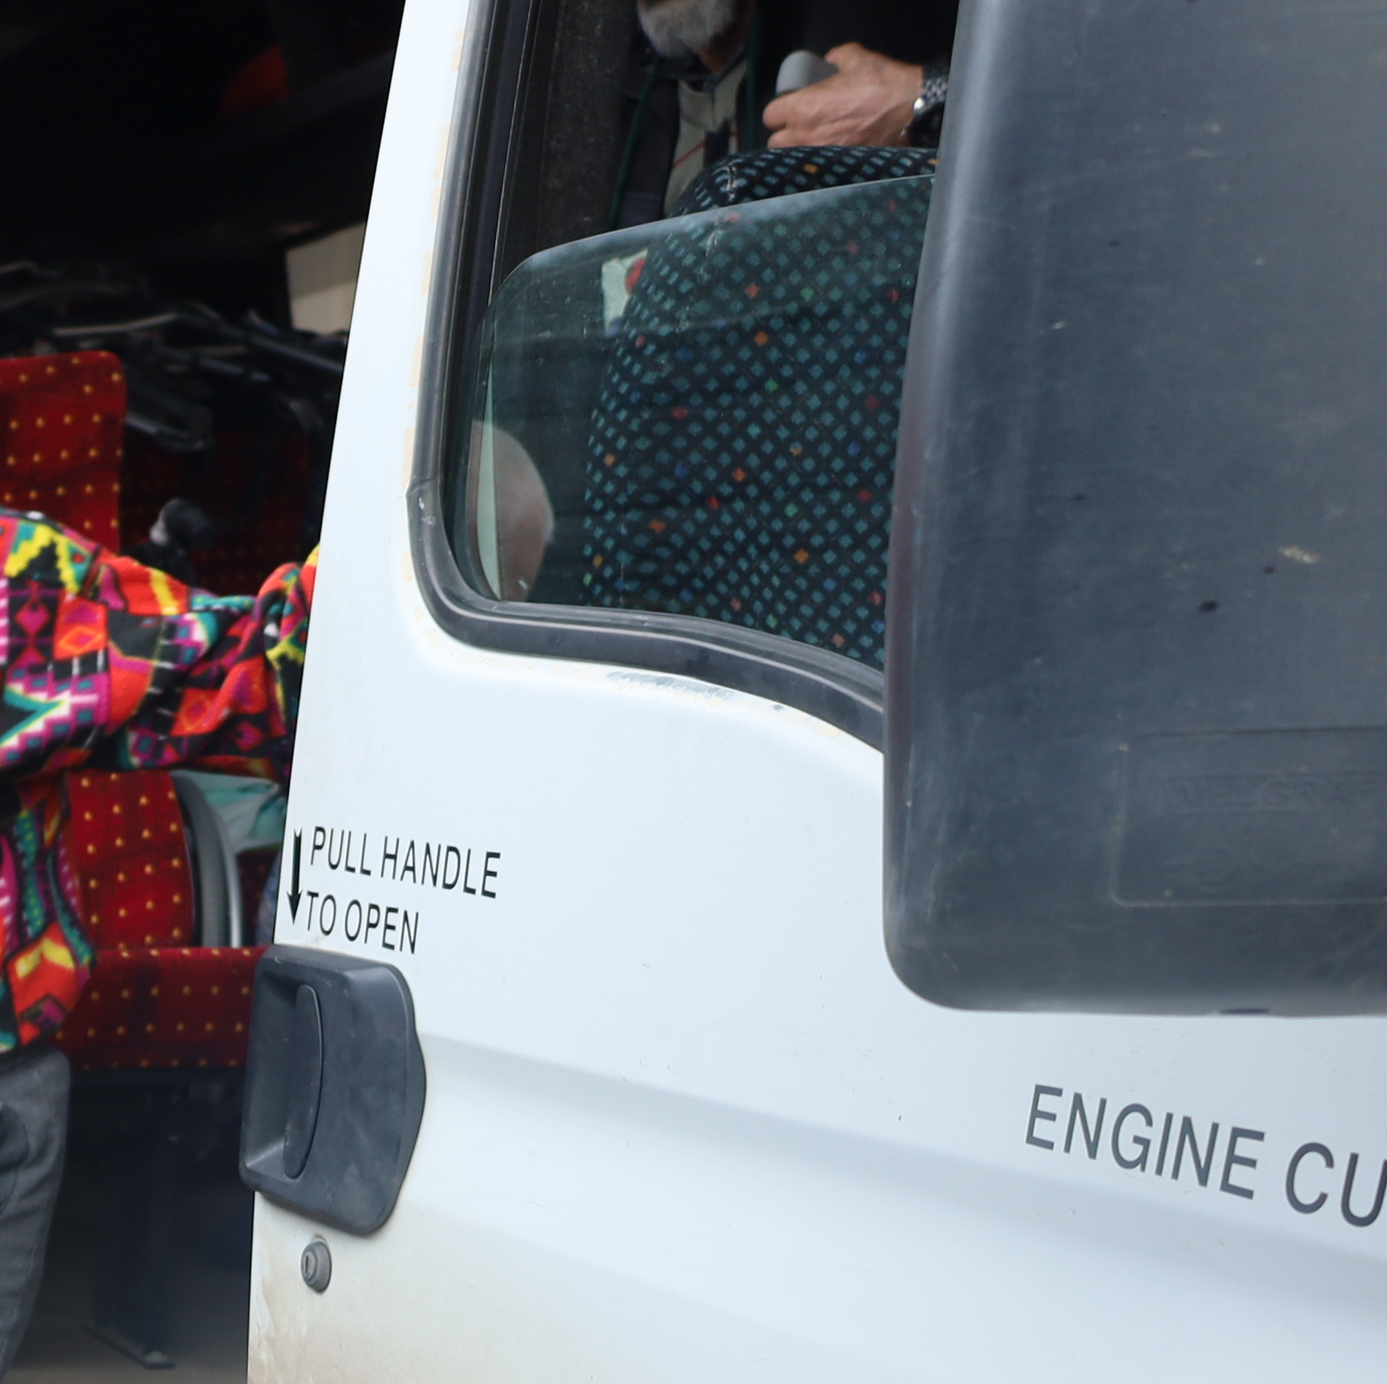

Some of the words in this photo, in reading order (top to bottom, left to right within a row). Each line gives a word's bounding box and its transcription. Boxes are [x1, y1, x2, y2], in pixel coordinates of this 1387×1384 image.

[310, 826, 371, 876] PULL
[381, 836, 501, 899] HANDLE
[306, 890, 337, 936] TO
[344, 899, 419, 955] OPEN
[1025, 1084, 1265, 1200] ENGINE
[1285, 1142, 1387, 1228] CU
